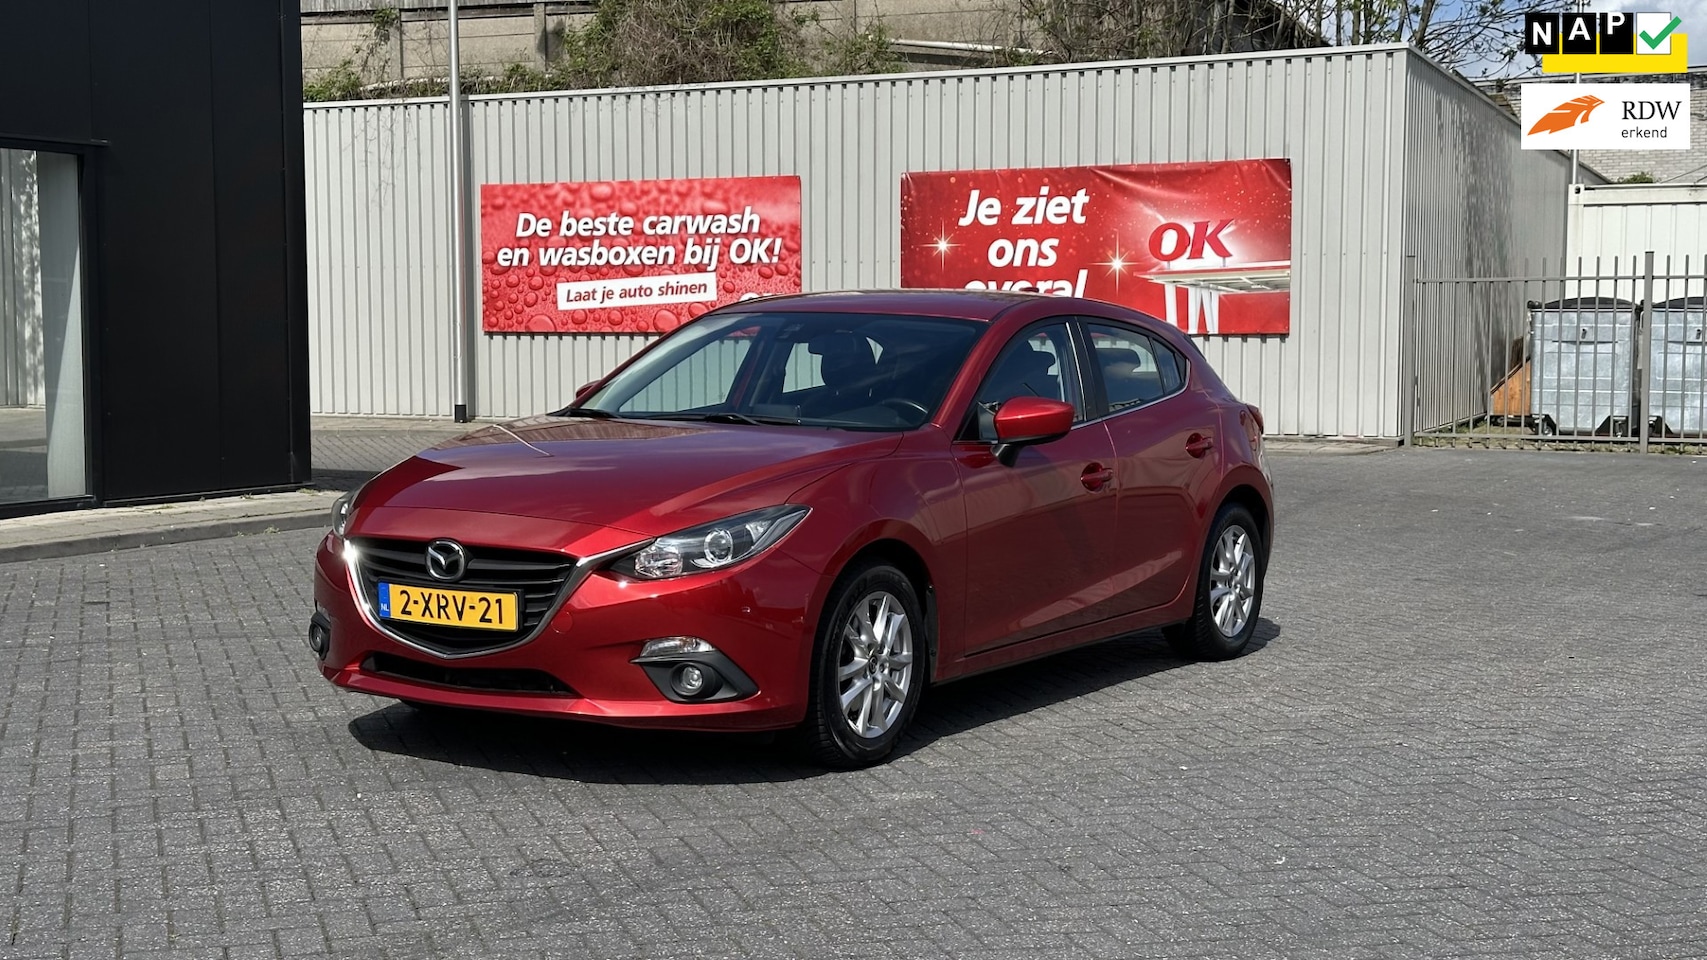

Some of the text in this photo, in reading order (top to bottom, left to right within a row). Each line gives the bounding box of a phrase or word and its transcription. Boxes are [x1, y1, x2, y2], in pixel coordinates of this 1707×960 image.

[515, 206, 760, 238] De beste carwash
[958, 186, 1090, 227] Je ziet
[496, 237, 782, 271] en wasboxen bij OK!
[987, 236, 1059, 268] ons
[1147, 218, 1236, 262] OK
[566, 280, 708, 306] Laat je auto shinen
[380, 603, 389, 612] NL
[399, 589, 503, 624] 2-XRV-21
